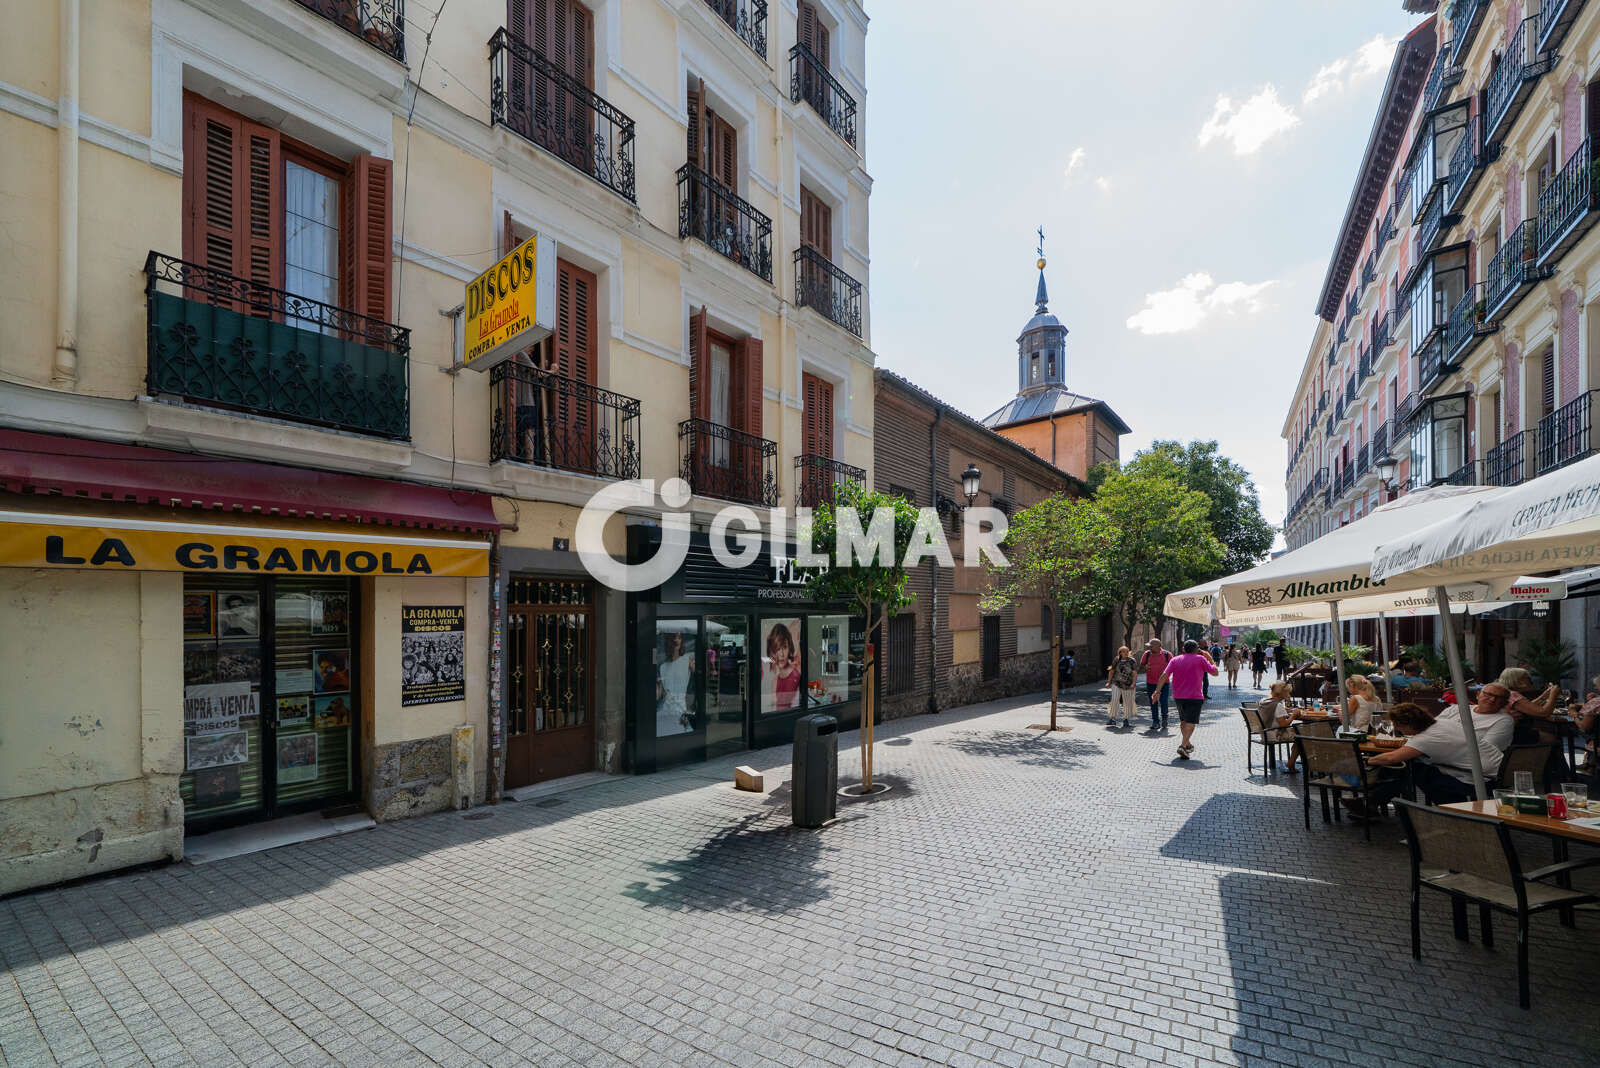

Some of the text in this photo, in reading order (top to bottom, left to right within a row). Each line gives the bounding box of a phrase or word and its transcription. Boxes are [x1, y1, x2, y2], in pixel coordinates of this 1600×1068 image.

[468, 242, 534, 322] DISCOS
[468, 335, 496, 360] COMPRA
[505, 315, 531, 338] VENTA
[1512, 495, 1561, 527] CERVEZA
[45, 535, 433, 574] LA GRAMOLA
[1198, 595, 1213, 606] Al
[1276, 574, 1386, 602] Alhambra
[1511, 586, 1550, 595] Mahou
[403, 608, 464, 619] LA GRAMOLA
[184, 697, 212, 720] MPRA
